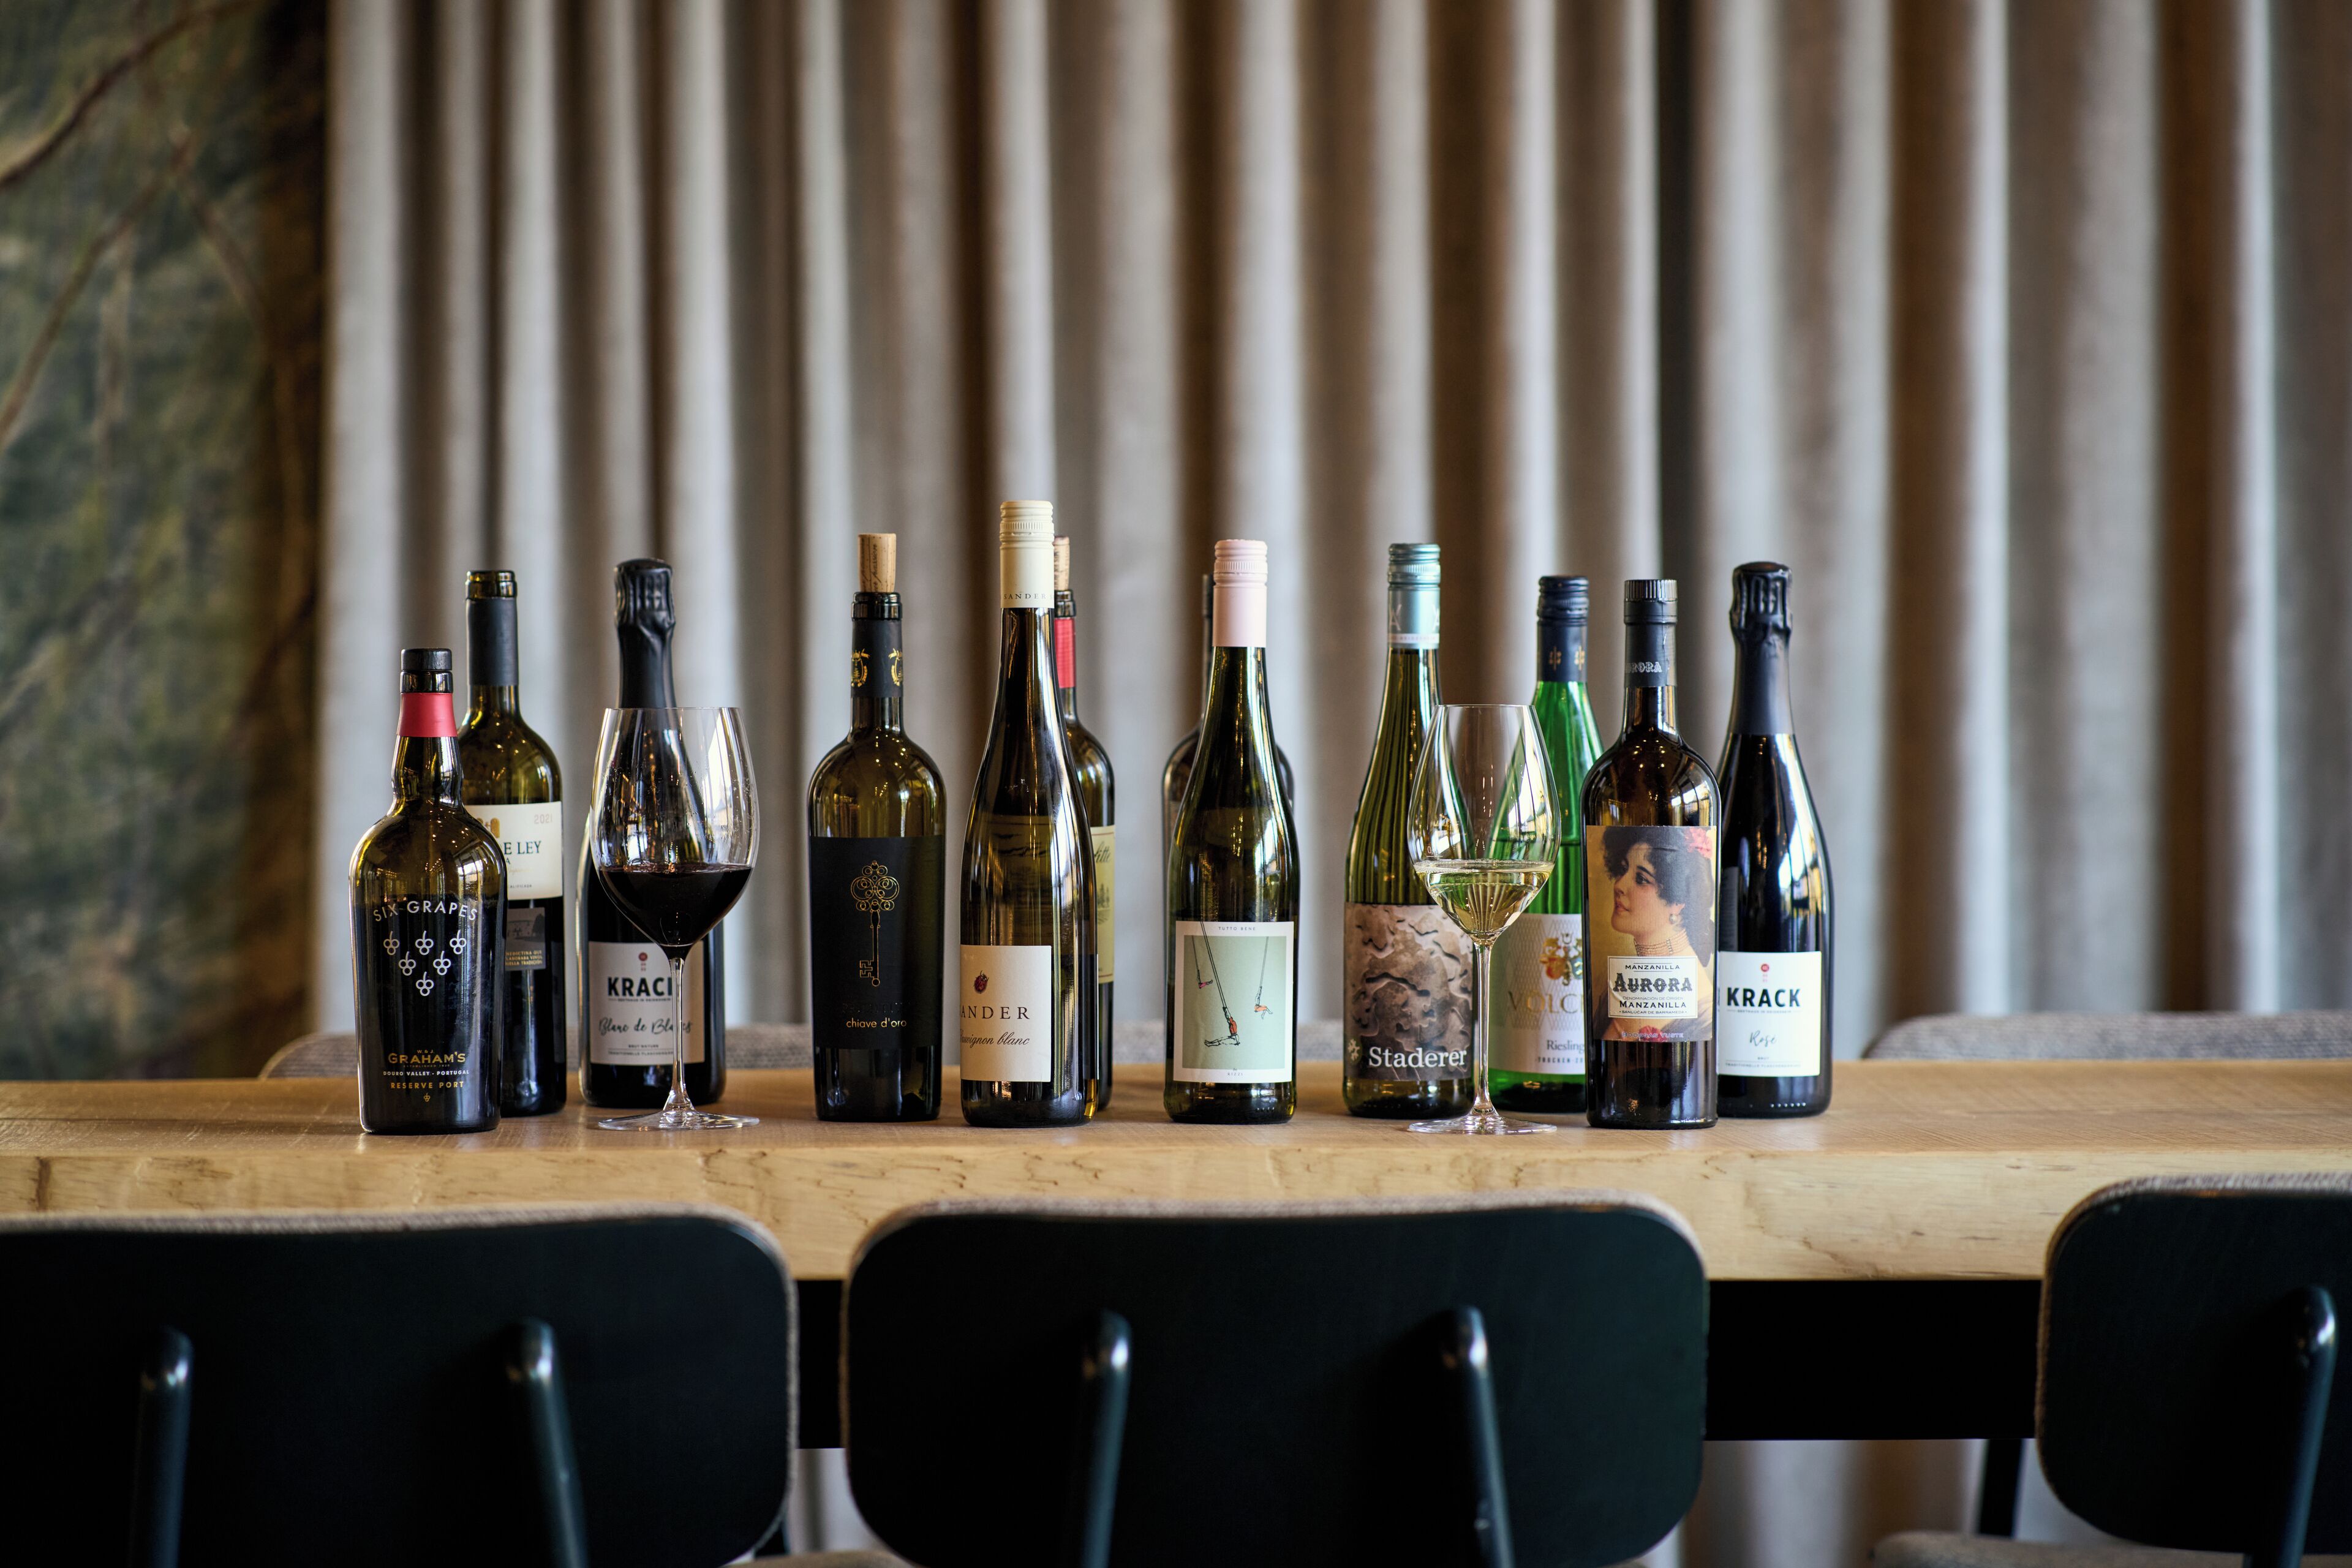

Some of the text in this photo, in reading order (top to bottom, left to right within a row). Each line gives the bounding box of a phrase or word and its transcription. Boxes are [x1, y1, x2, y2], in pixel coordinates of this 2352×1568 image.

[1626, 661, 1662, 673] RORA
[534, 813, 553, 824] 2021
[503, 840, 541, 854] E LEY
[373, 900, 478, 922] SIX GRAPES
[1613, 972, 1692, 993] AURORA
[1727, 987, 1801, 1007] KRACK
[960, 1006, 1030, 1019] ANDER
[598, 1017, 692, 1036] Blanc de Blacs
[846, 1017, 907, 1028] chiave d'oro
[997, 1031, 1030, 1045] blanc
[1547, 1039, 1585, 1054] Riesling
[388, 1051, 466, 1064] GRAHAM'S
[1368, 1046, 1467, 1068] Staderer
